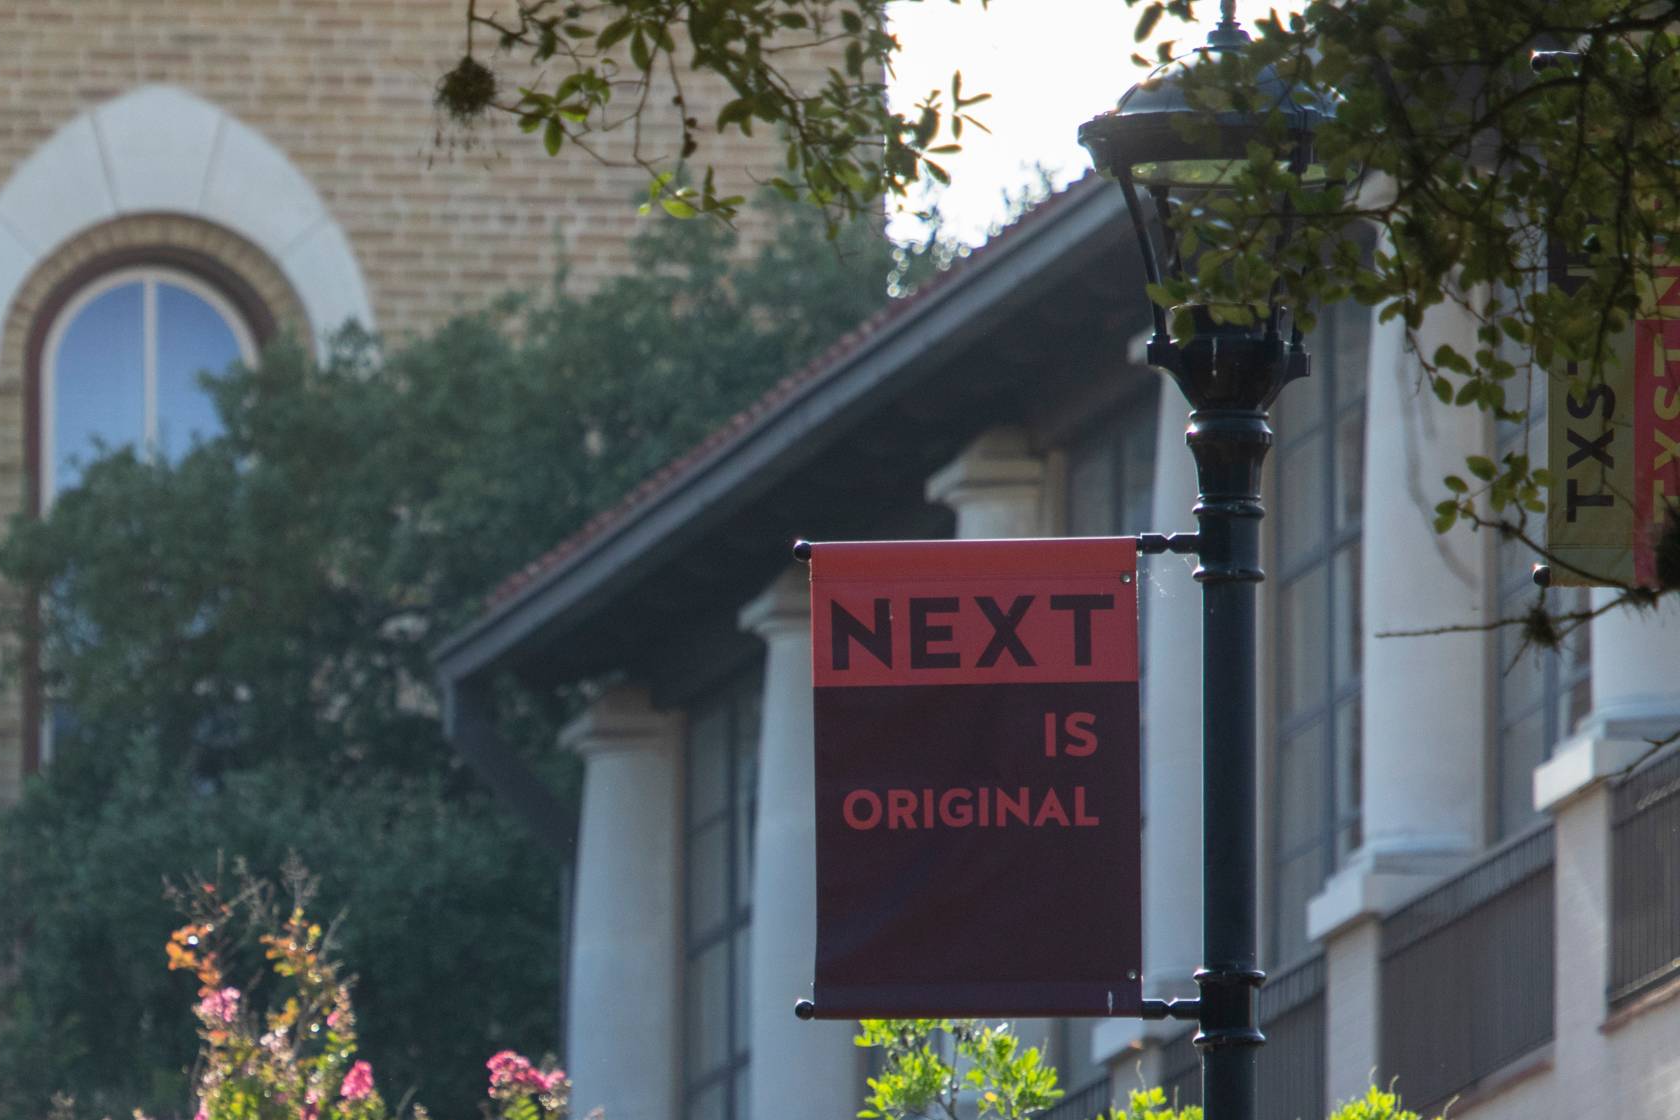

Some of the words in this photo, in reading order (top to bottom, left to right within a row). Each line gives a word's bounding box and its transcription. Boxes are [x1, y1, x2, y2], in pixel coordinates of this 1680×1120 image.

[1566, 360, 1616, 523] TXS
[830, 595, 1115, 670] NEXT
[1045, 713, 1097, 757] IS
[843, 787, 1100, 830] ORIGINAL
